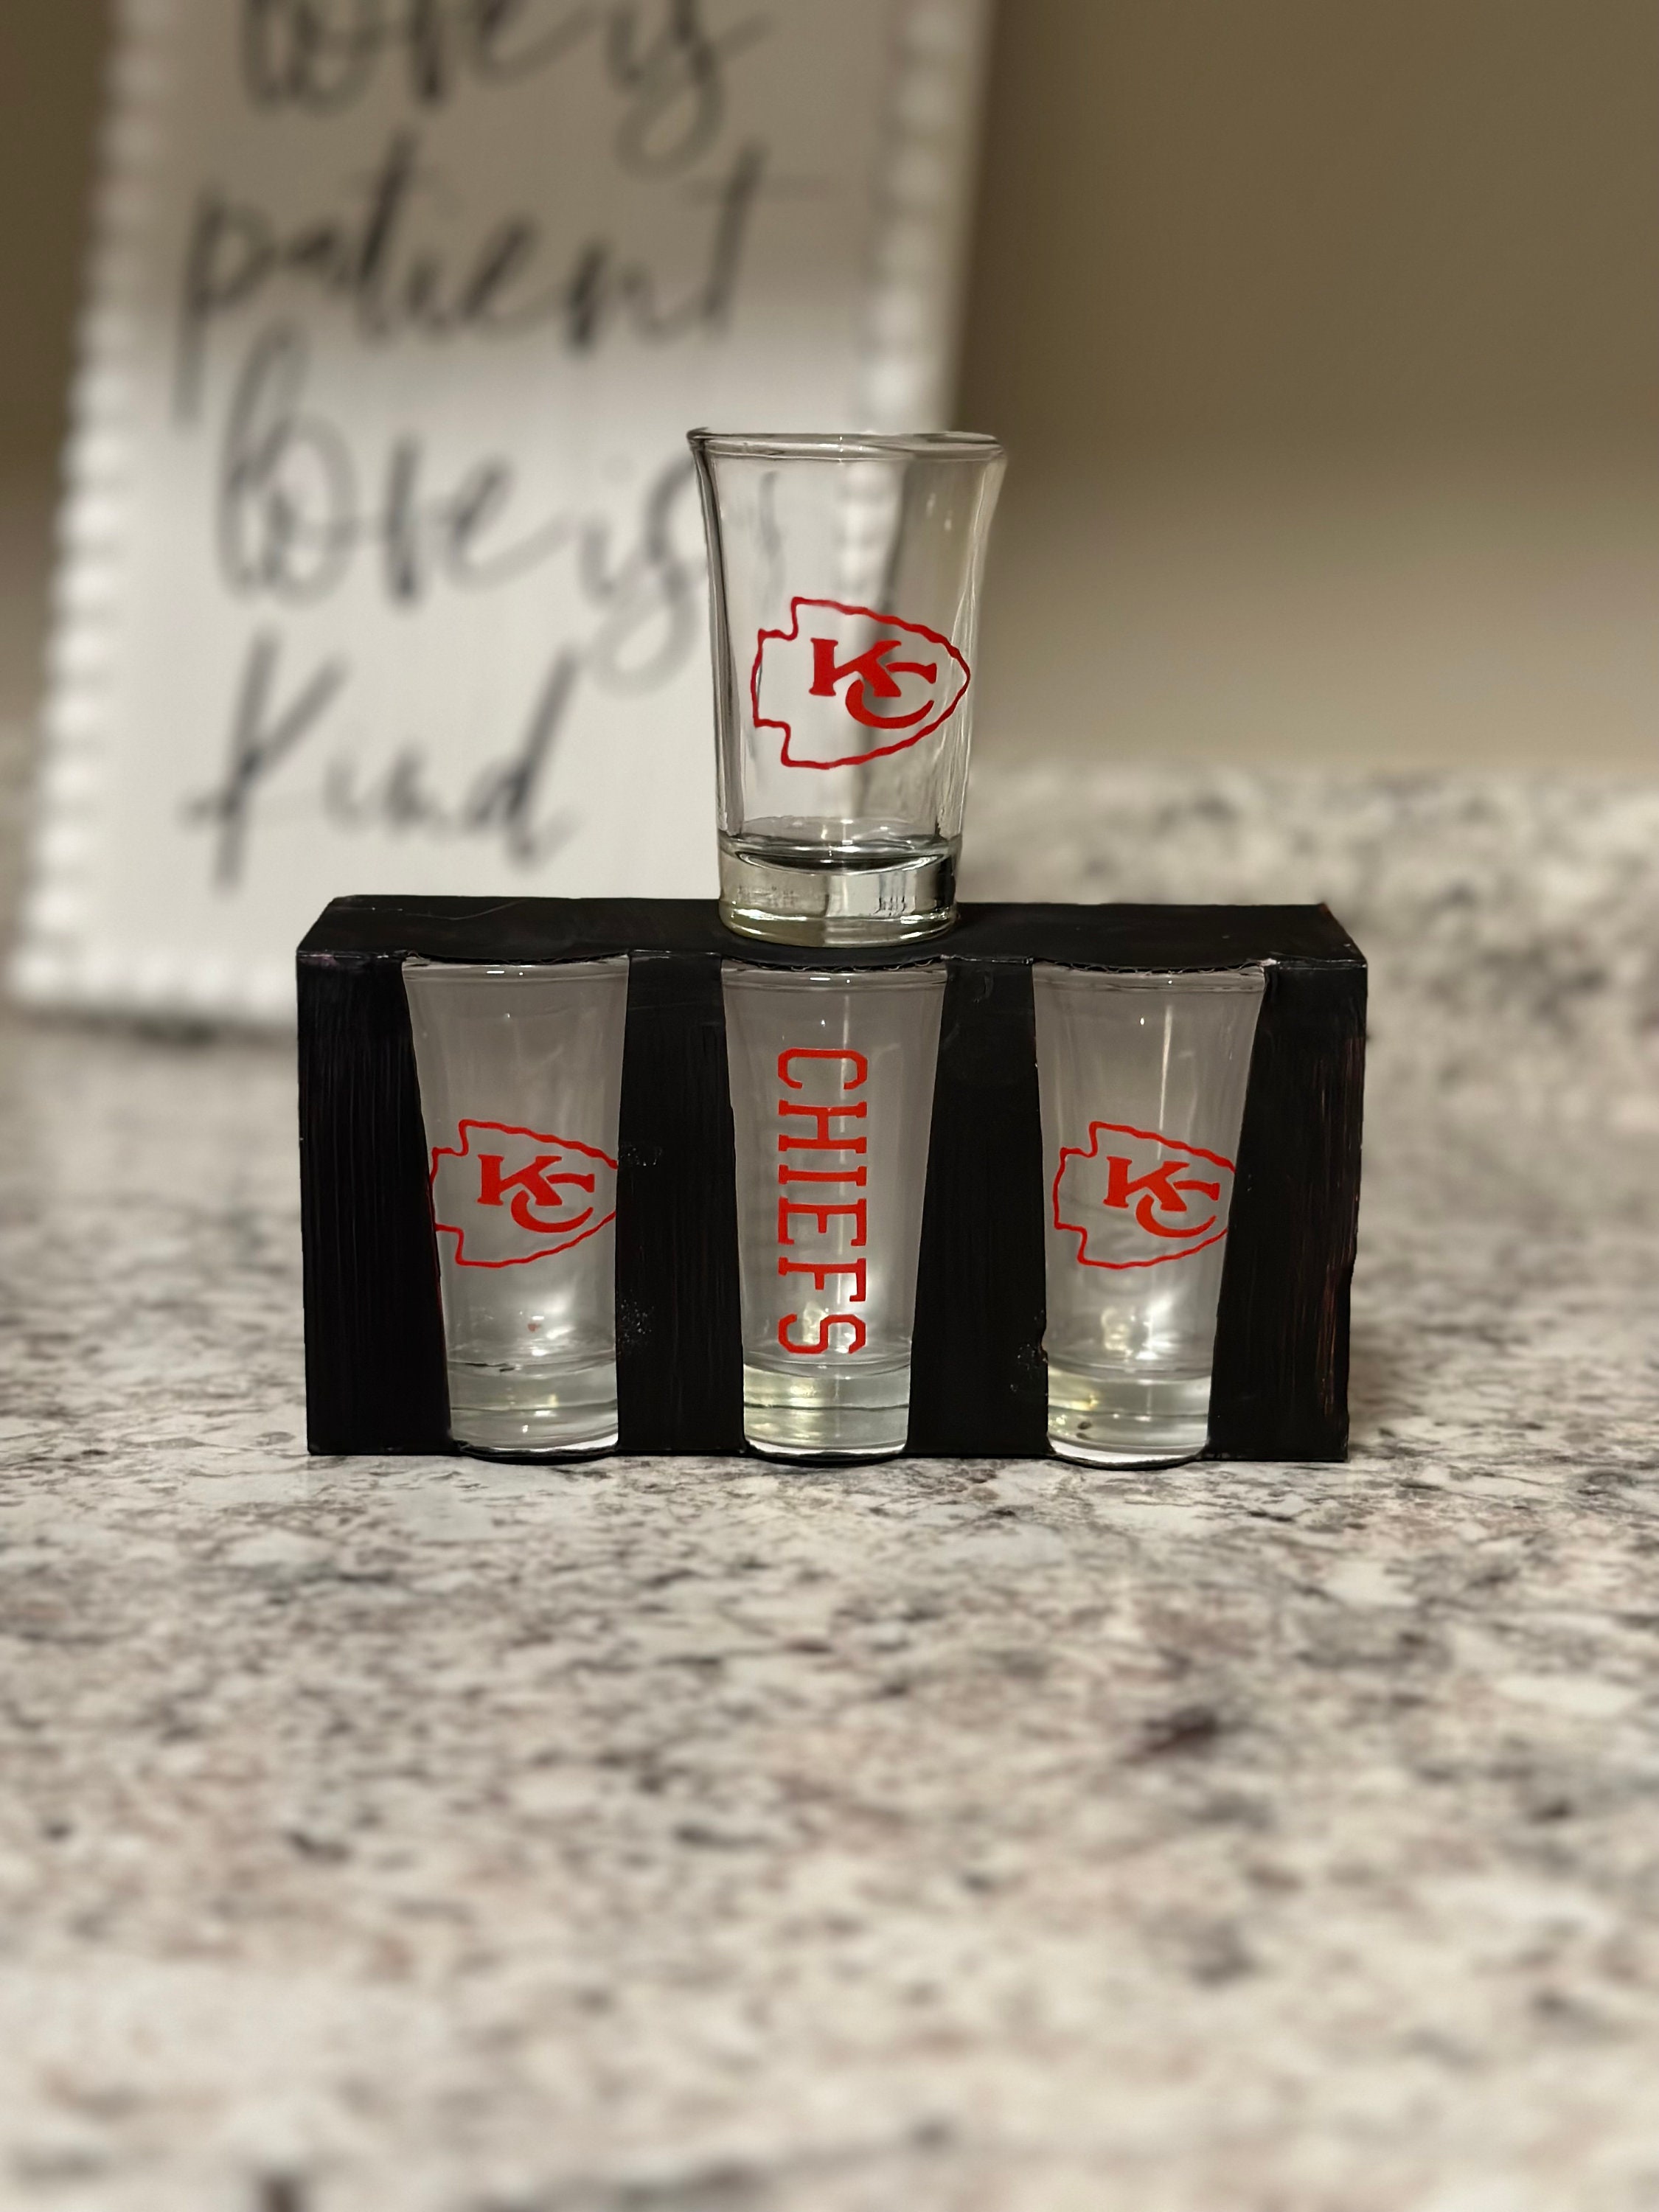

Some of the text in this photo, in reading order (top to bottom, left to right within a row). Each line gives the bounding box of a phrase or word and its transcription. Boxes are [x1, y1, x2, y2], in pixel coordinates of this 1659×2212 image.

[177, 125, 827, 424] patient
[215, 319, 579, 611] love
[809, 638, 936, 728] KC
[477, 1155, 595, 1233] KC
[778, 1048, 867, 1354] CHIEFS
[1104, 1157, 1221, 1238] KC
